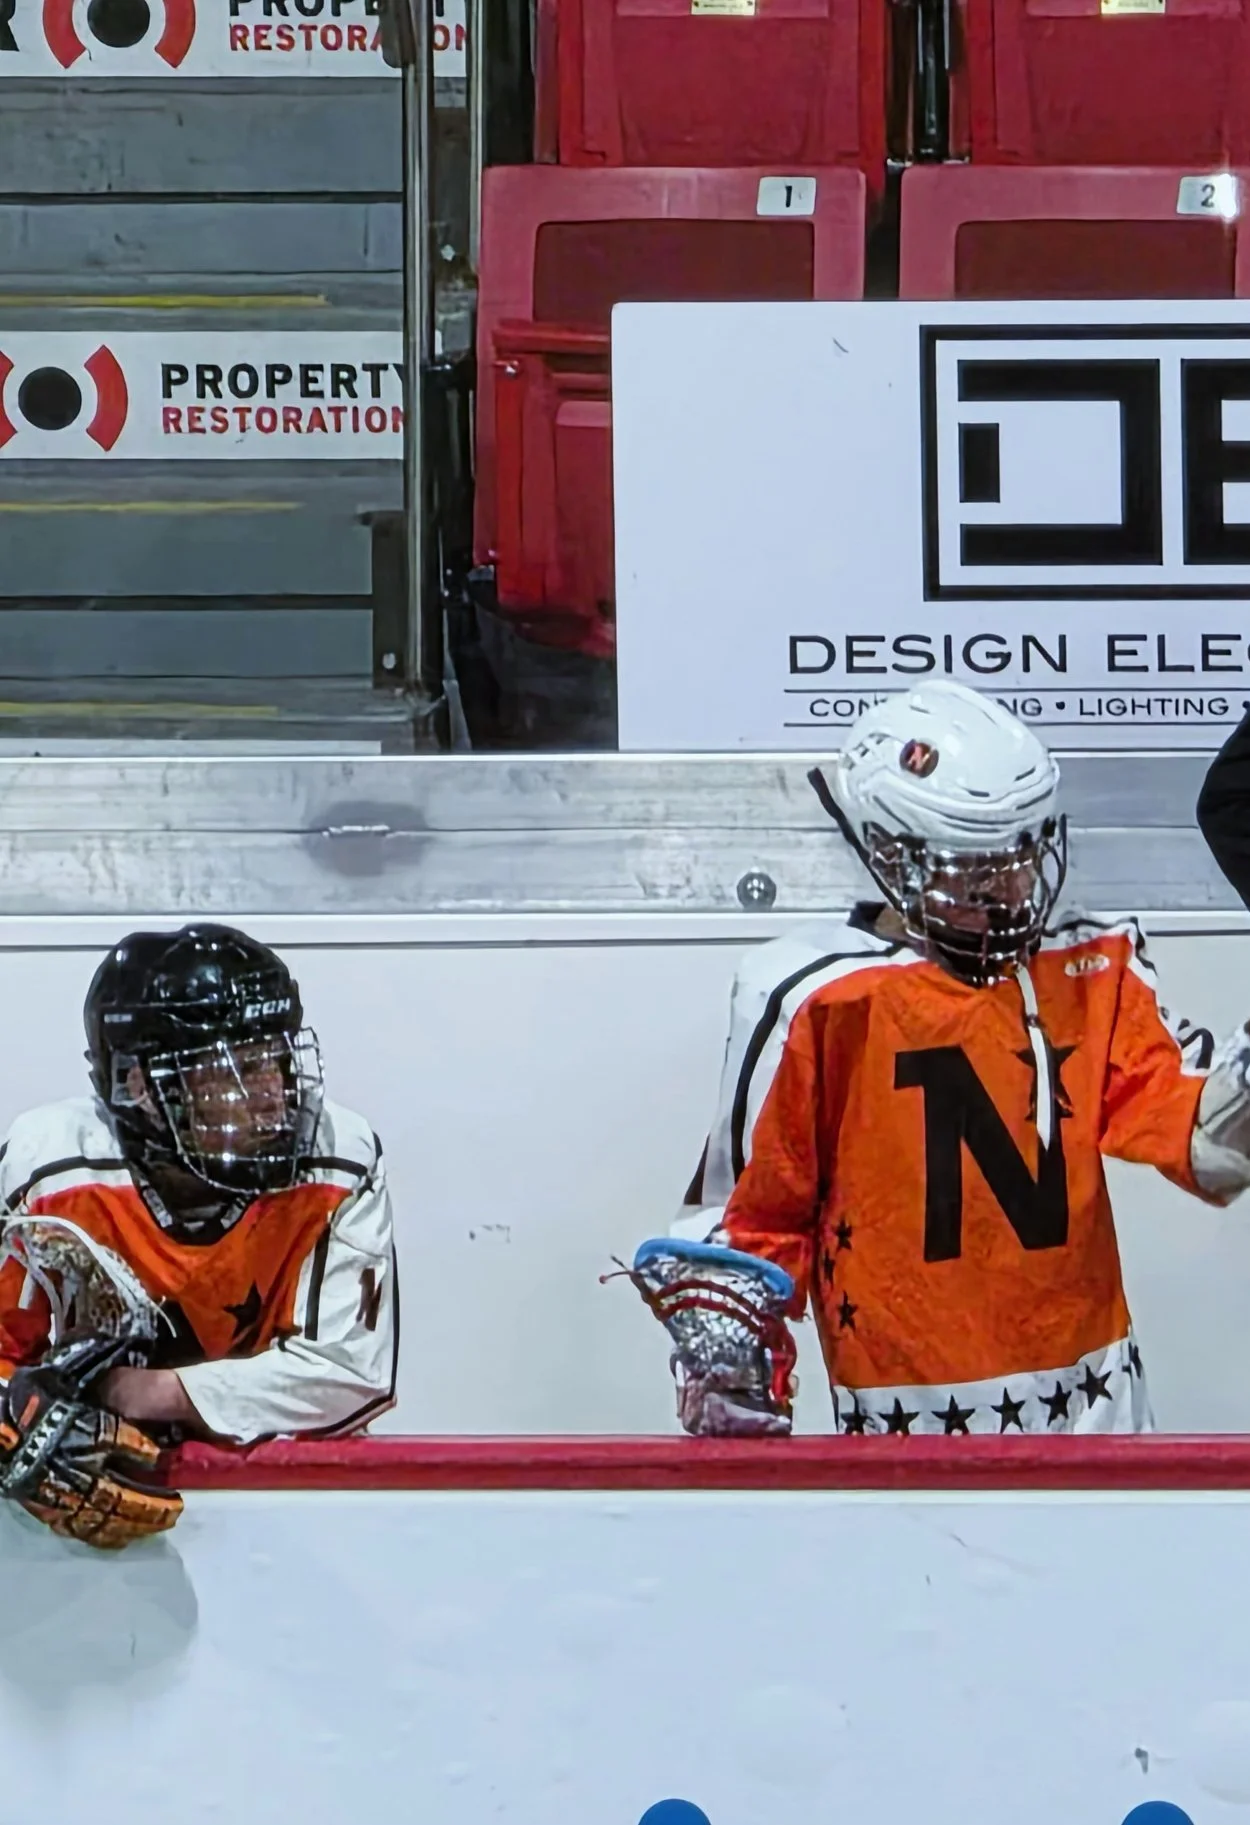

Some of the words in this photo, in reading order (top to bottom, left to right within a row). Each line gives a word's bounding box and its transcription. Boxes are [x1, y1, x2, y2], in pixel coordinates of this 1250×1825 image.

[229, 24, 466, 51] RESTORON
[784, 186, 793, 208] 1
[1199, 184, 1216, 208] 2
[163, 406, 404, 434] RESTORATION
[789, 634, 1068, 675] DESIGN
[1079, 697, 1230, 716] LIGHTING
[894, 1044, 1069, 1263] N
